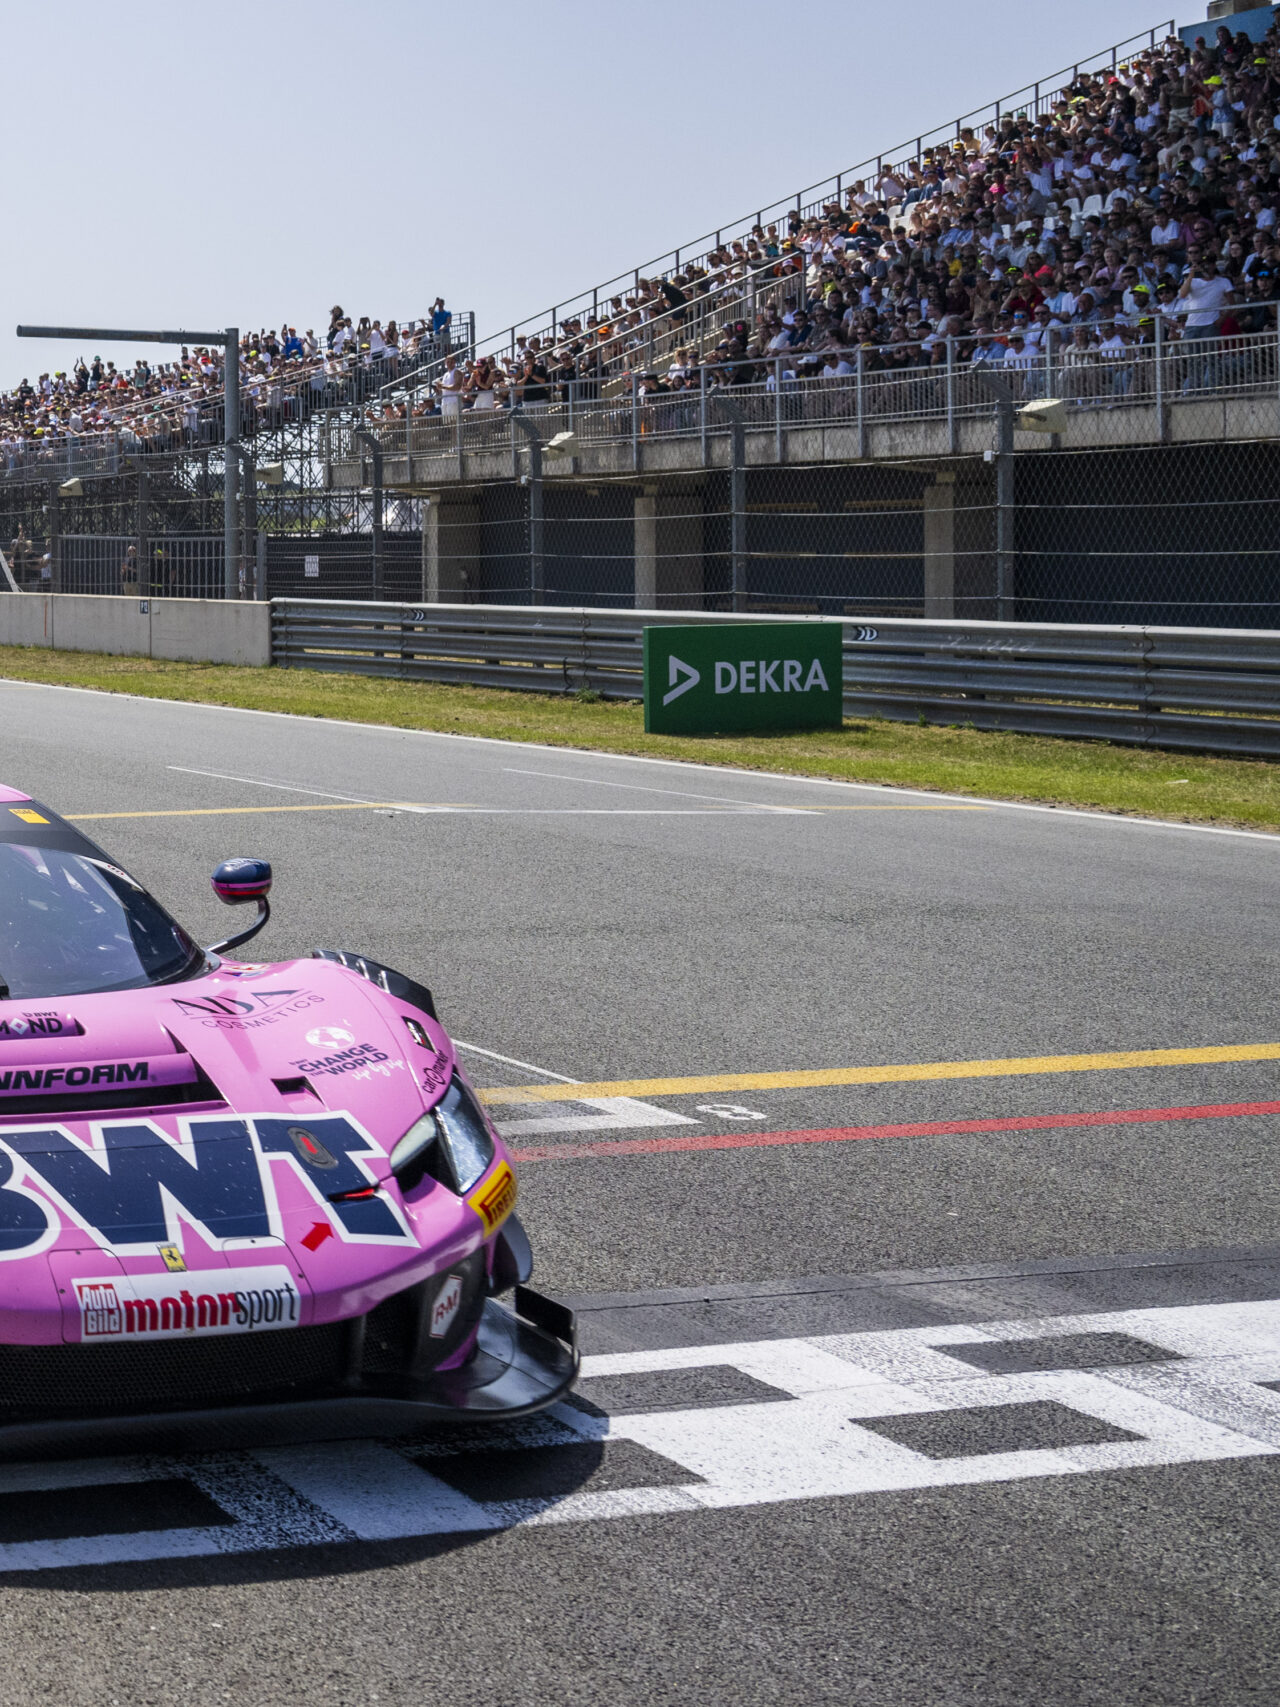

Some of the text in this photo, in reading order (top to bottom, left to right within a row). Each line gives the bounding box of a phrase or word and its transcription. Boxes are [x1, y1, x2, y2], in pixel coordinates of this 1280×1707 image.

[714, 658, 829, 694] DEKRA
[201, 994, 326, 1030] COSMETICS
[298, 1043, 378, 1072] CHANGE
[325, 1052, 389, 1075] WORLD
[478, 1170, 517, 1226] PIRELL
[80, 1284, 117, 1309] Auto
[86, 1309, 121, 1333] Bild
